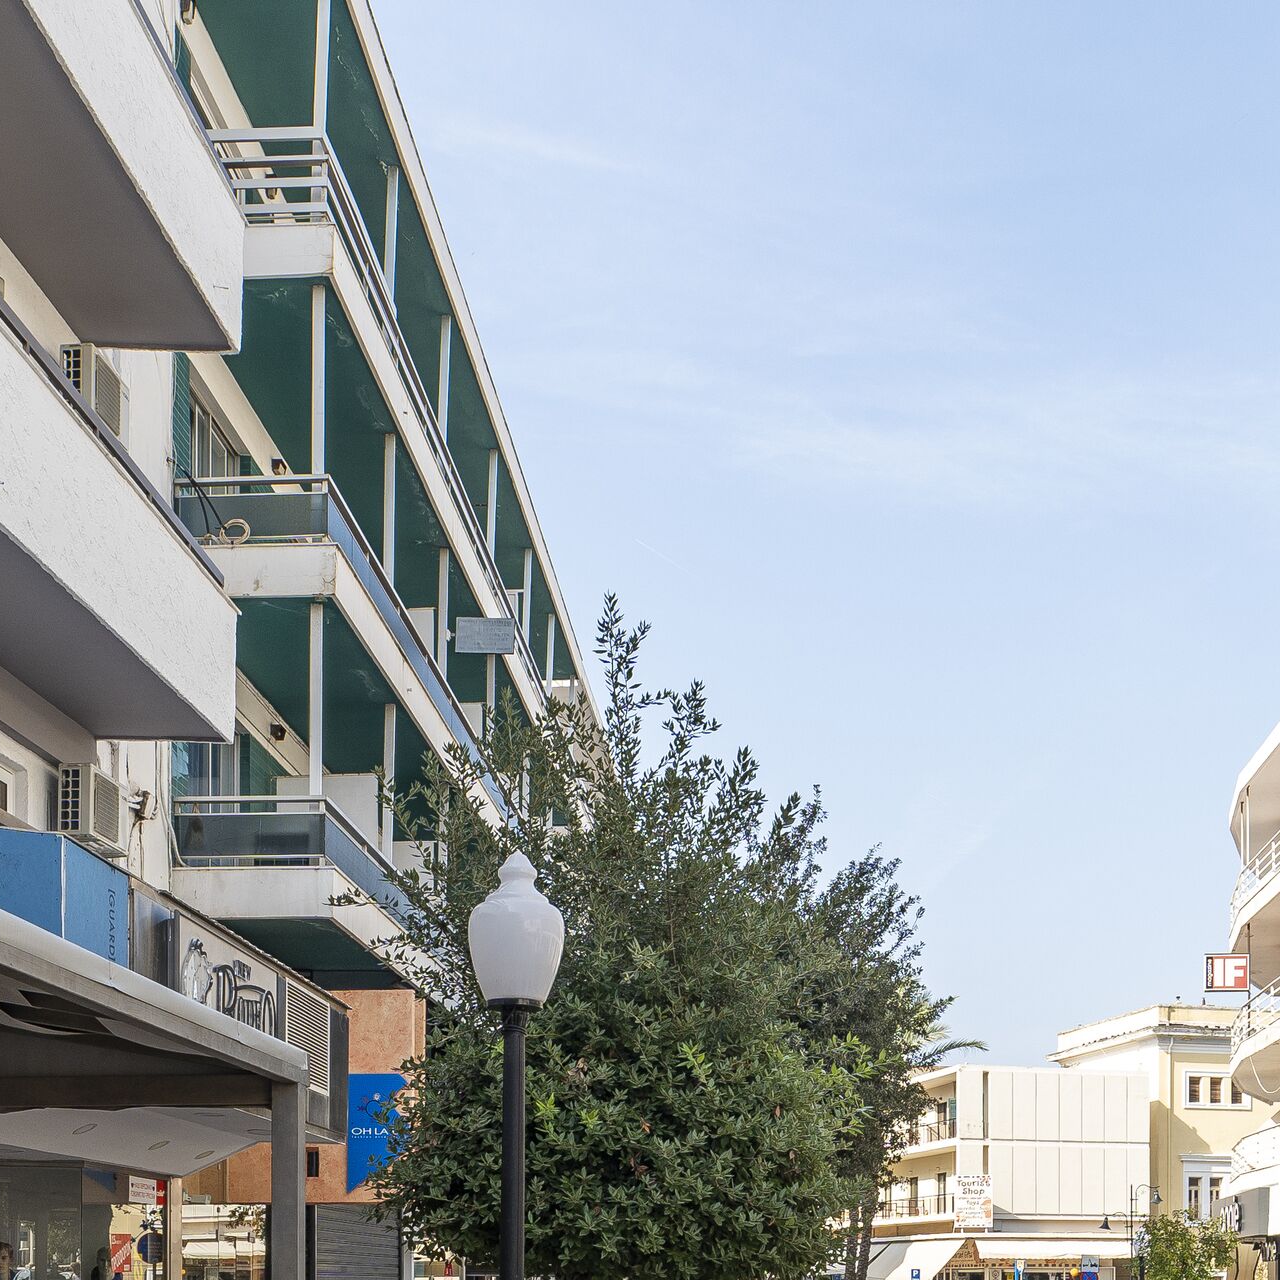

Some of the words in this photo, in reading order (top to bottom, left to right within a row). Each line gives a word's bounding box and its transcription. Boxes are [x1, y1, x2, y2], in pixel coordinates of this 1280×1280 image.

[1213, 958, 1247, 987] IF
[351, 1127, 372, 1136] OH
[374, 1127, 389, 1136] LA
[962, 1188, 985, 1196] Shop
[913, 1269, 919, 1277] P
